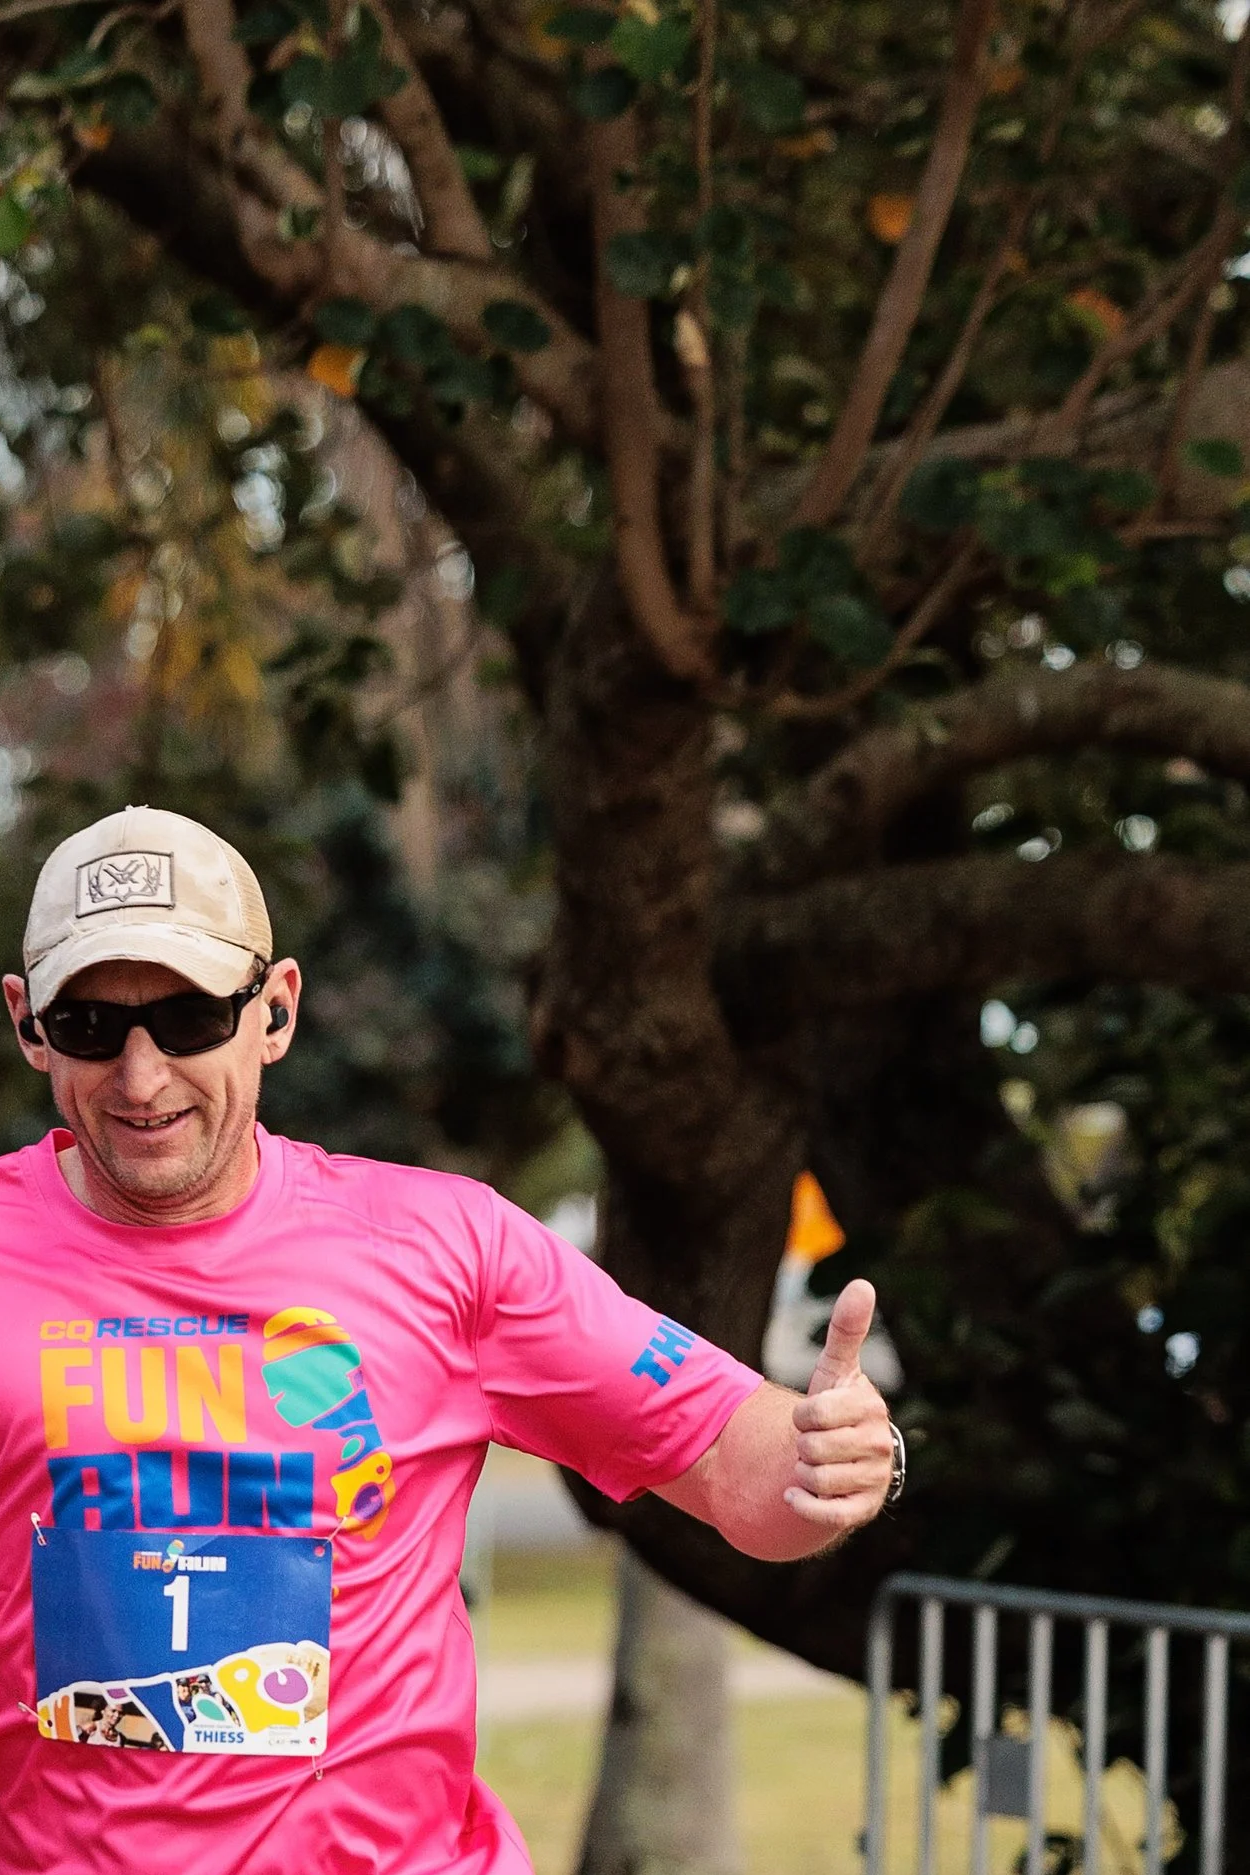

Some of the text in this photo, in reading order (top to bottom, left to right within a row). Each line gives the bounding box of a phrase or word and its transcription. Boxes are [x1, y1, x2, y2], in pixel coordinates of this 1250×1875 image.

[96, 1314, 249, 1339] RESCUE
[40, 1343, 248, 1449] FUN
[47, 1451, 315, 1530] RUN
[133, 1551, 163, 1570] FUN
[163, 1575, 190, 1652] 1
[194, 1730, 245, 1744] THIESS
